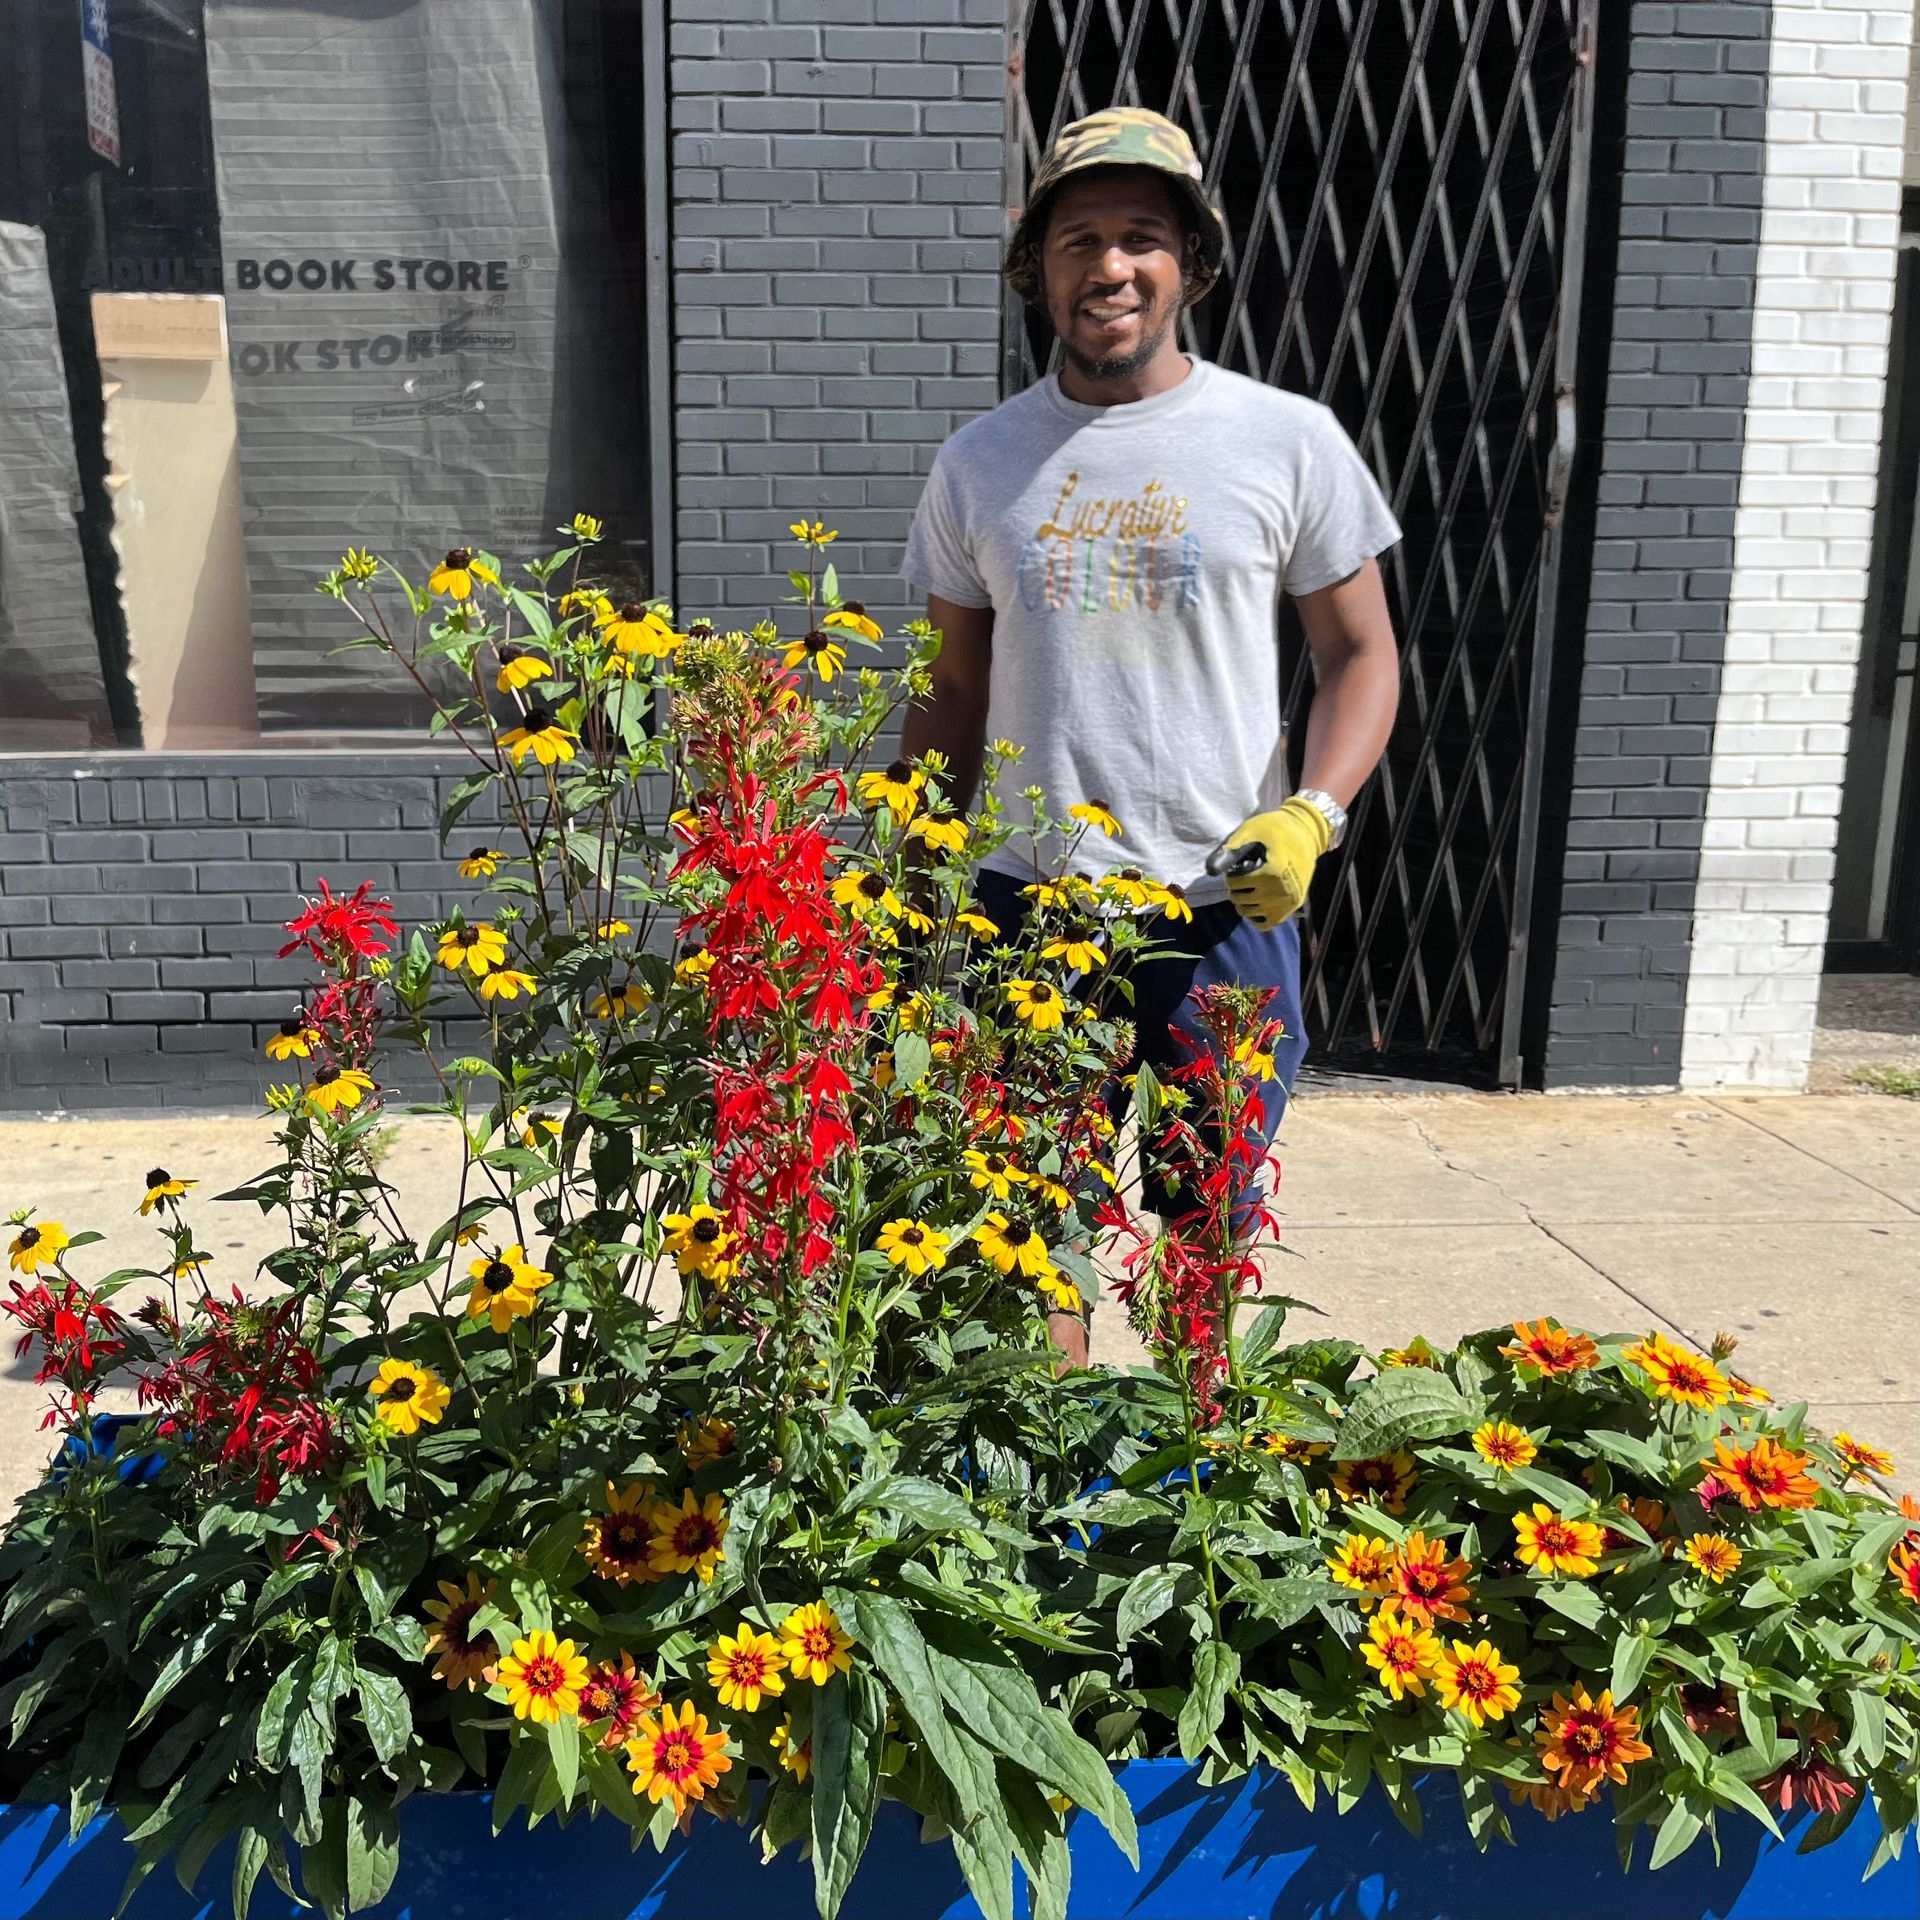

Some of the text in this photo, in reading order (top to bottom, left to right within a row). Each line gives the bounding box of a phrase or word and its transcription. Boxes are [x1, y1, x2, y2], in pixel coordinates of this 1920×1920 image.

[237, 259, 358, 291] BOOK
[373, 260, 509, 291] STORE
[469, 333, 513, 347] chicago
